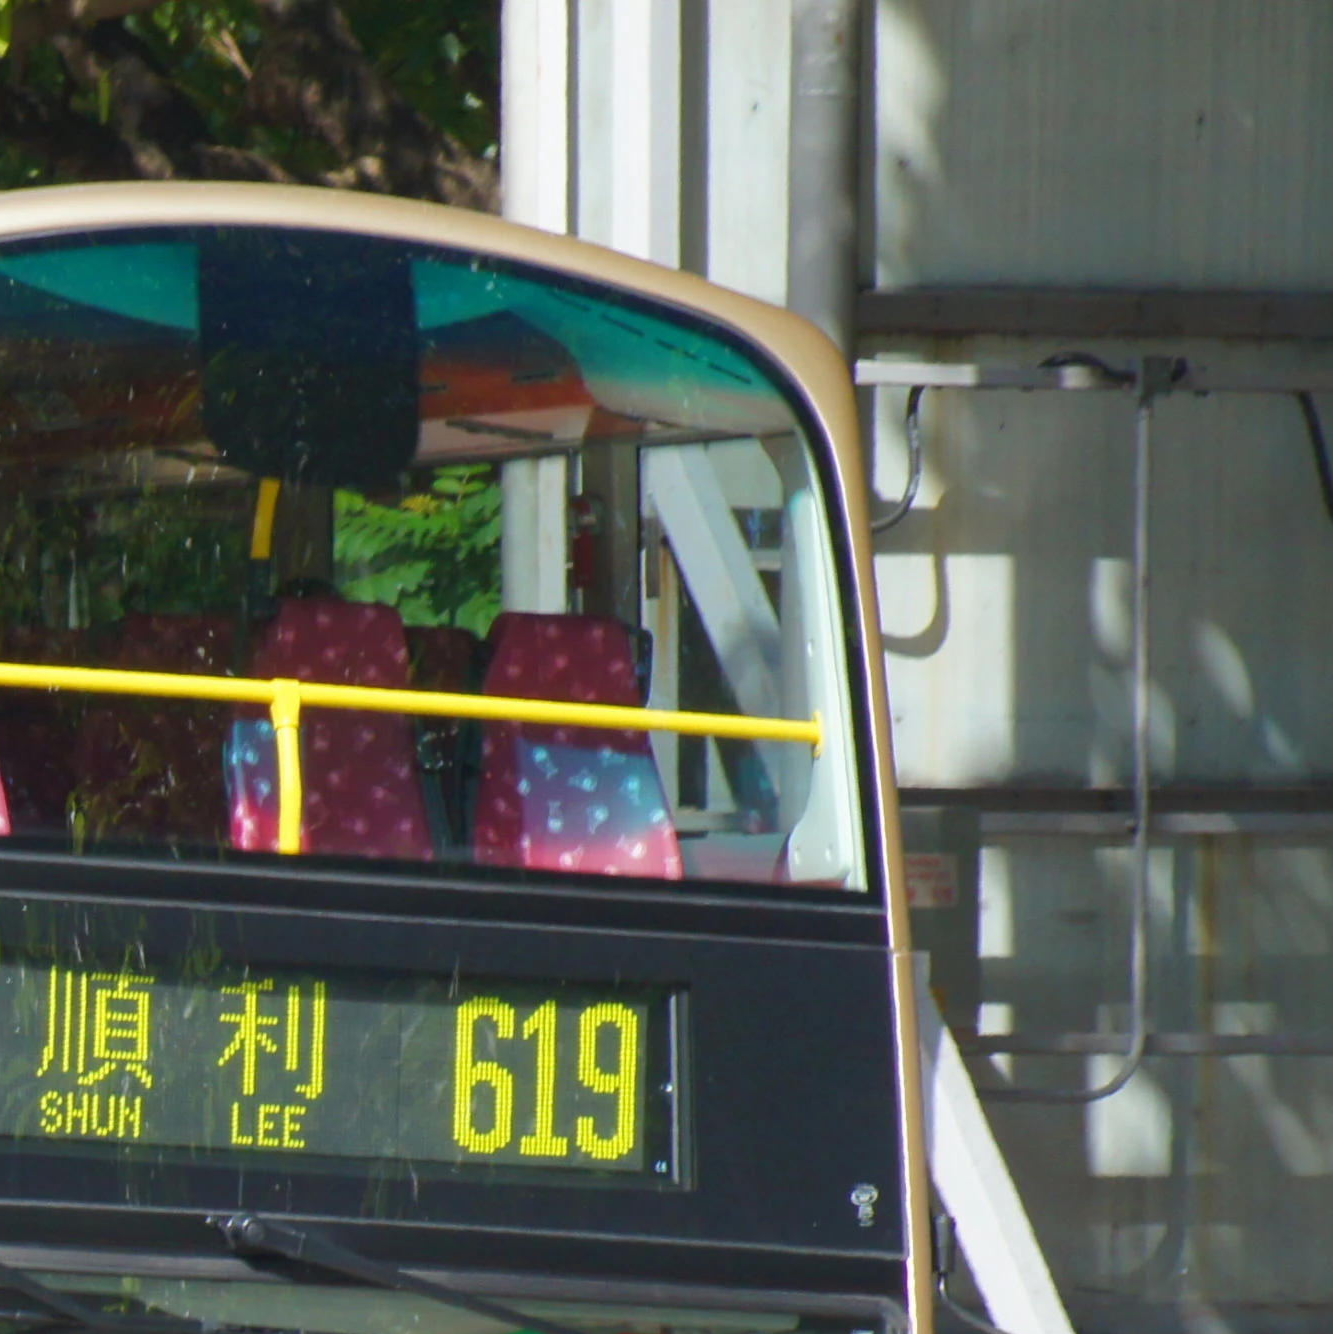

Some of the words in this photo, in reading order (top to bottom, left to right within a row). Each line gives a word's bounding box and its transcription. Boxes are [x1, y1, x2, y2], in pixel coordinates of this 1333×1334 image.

[39, 1091, 141, 1138] SHUN
[231, 1102, 306, 1149] LEE
[453, 995, 638, 1160] 619
